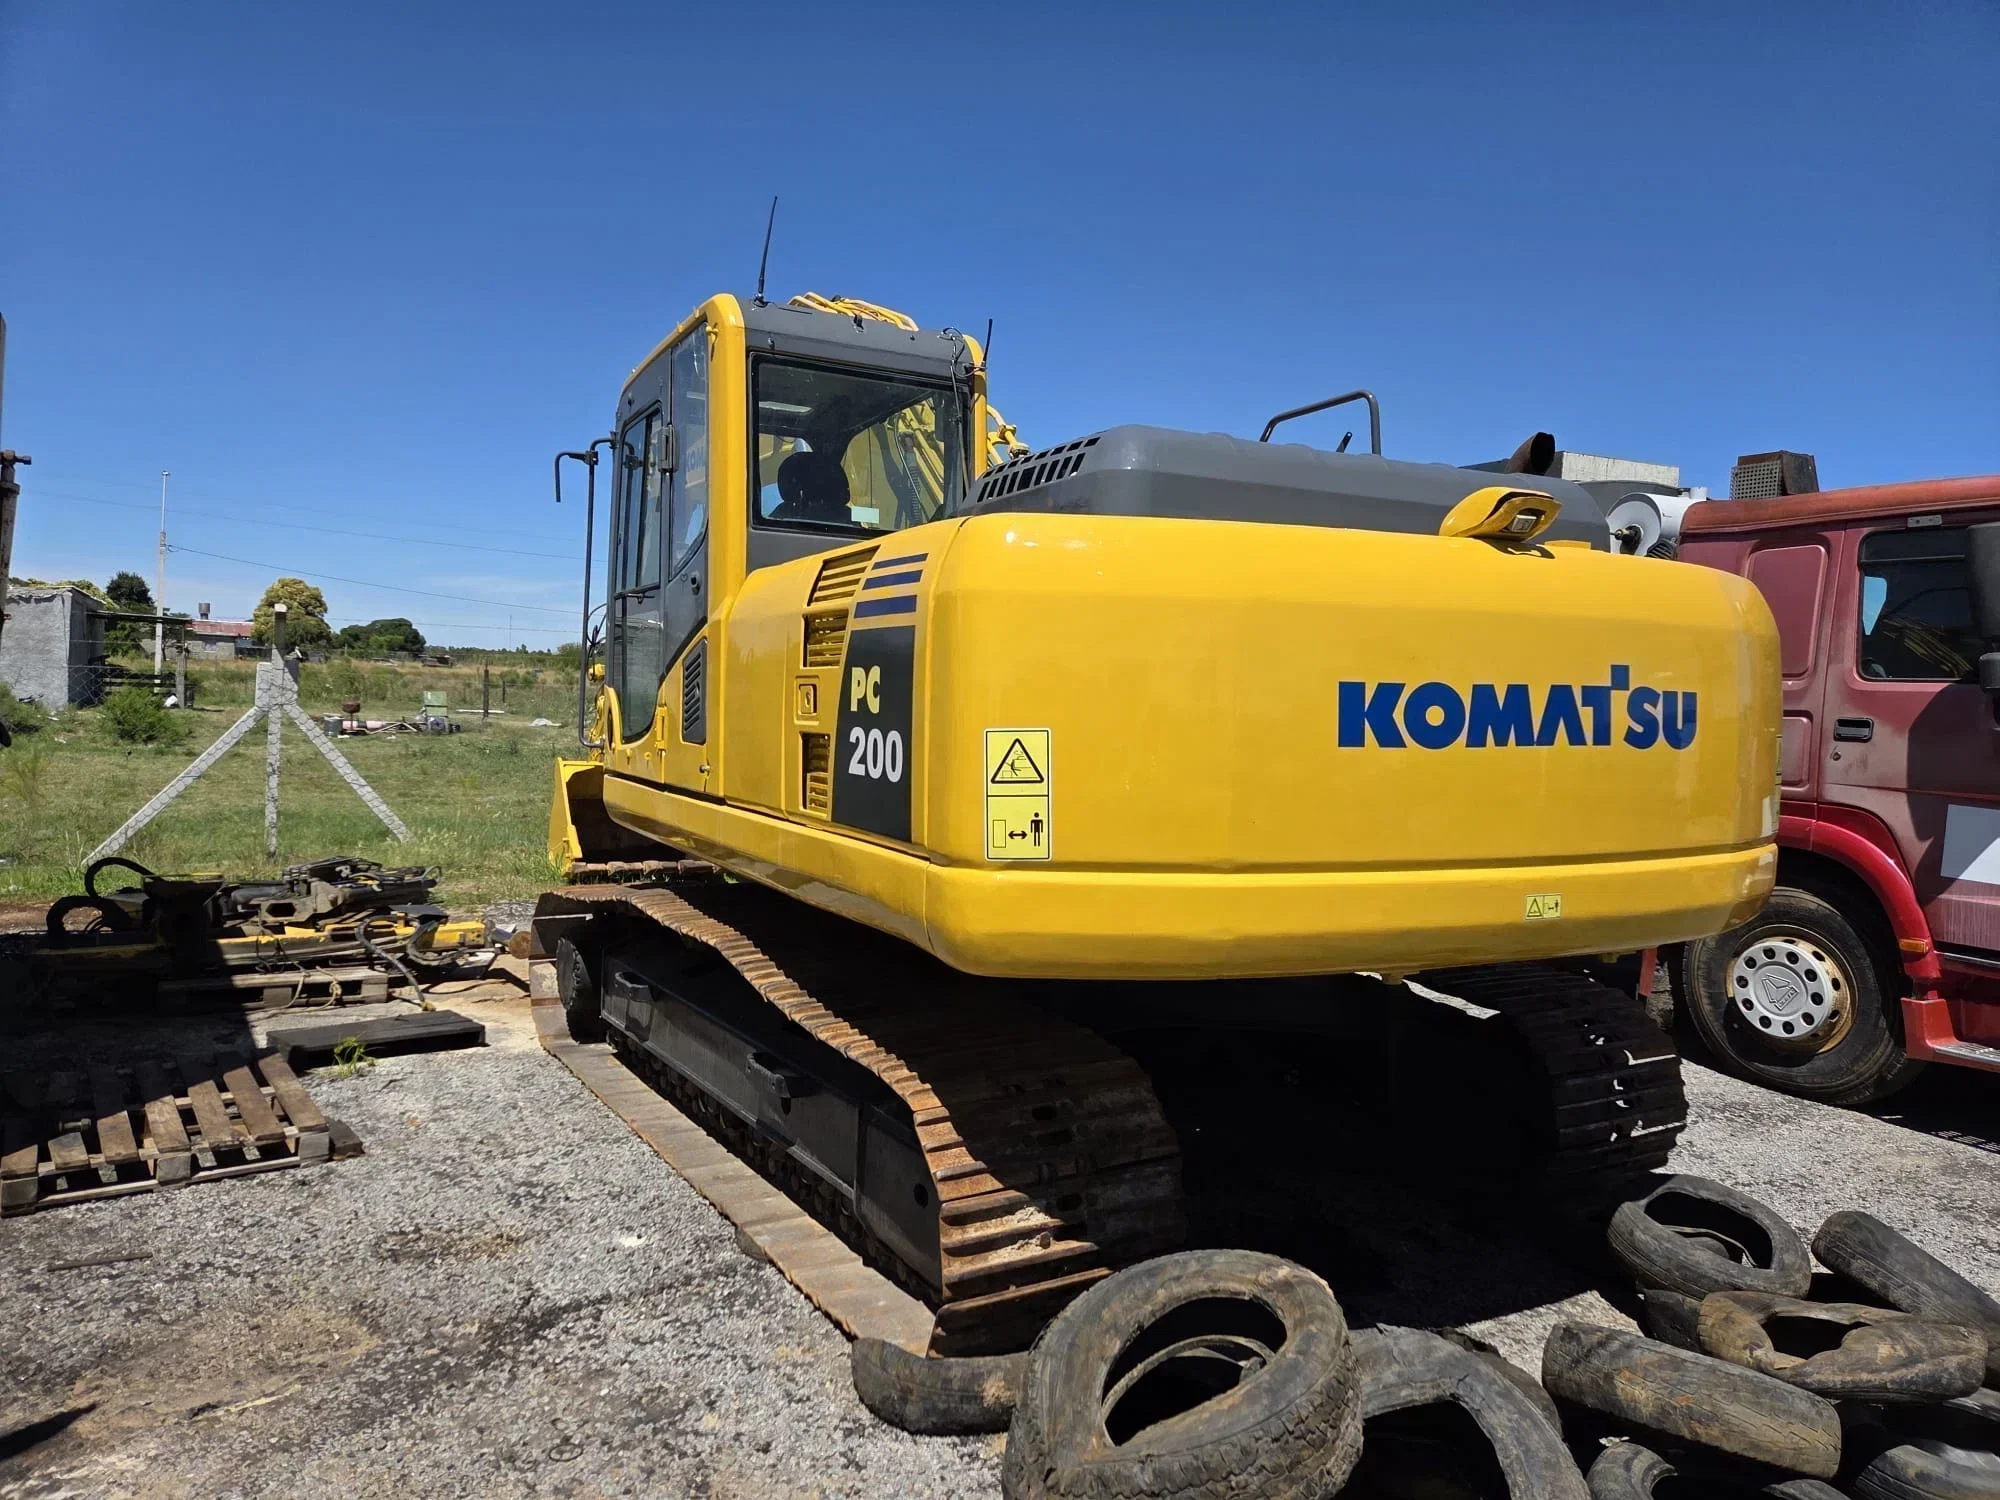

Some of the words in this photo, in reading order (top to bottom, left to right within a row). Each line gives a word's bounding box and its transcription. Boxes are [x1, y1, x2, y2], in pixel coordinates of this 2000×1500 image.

[849, 665, 881, 714] PC
[1338, 664, 1697, 749] KOMATSU
[848, 726, 904, 783] 200
